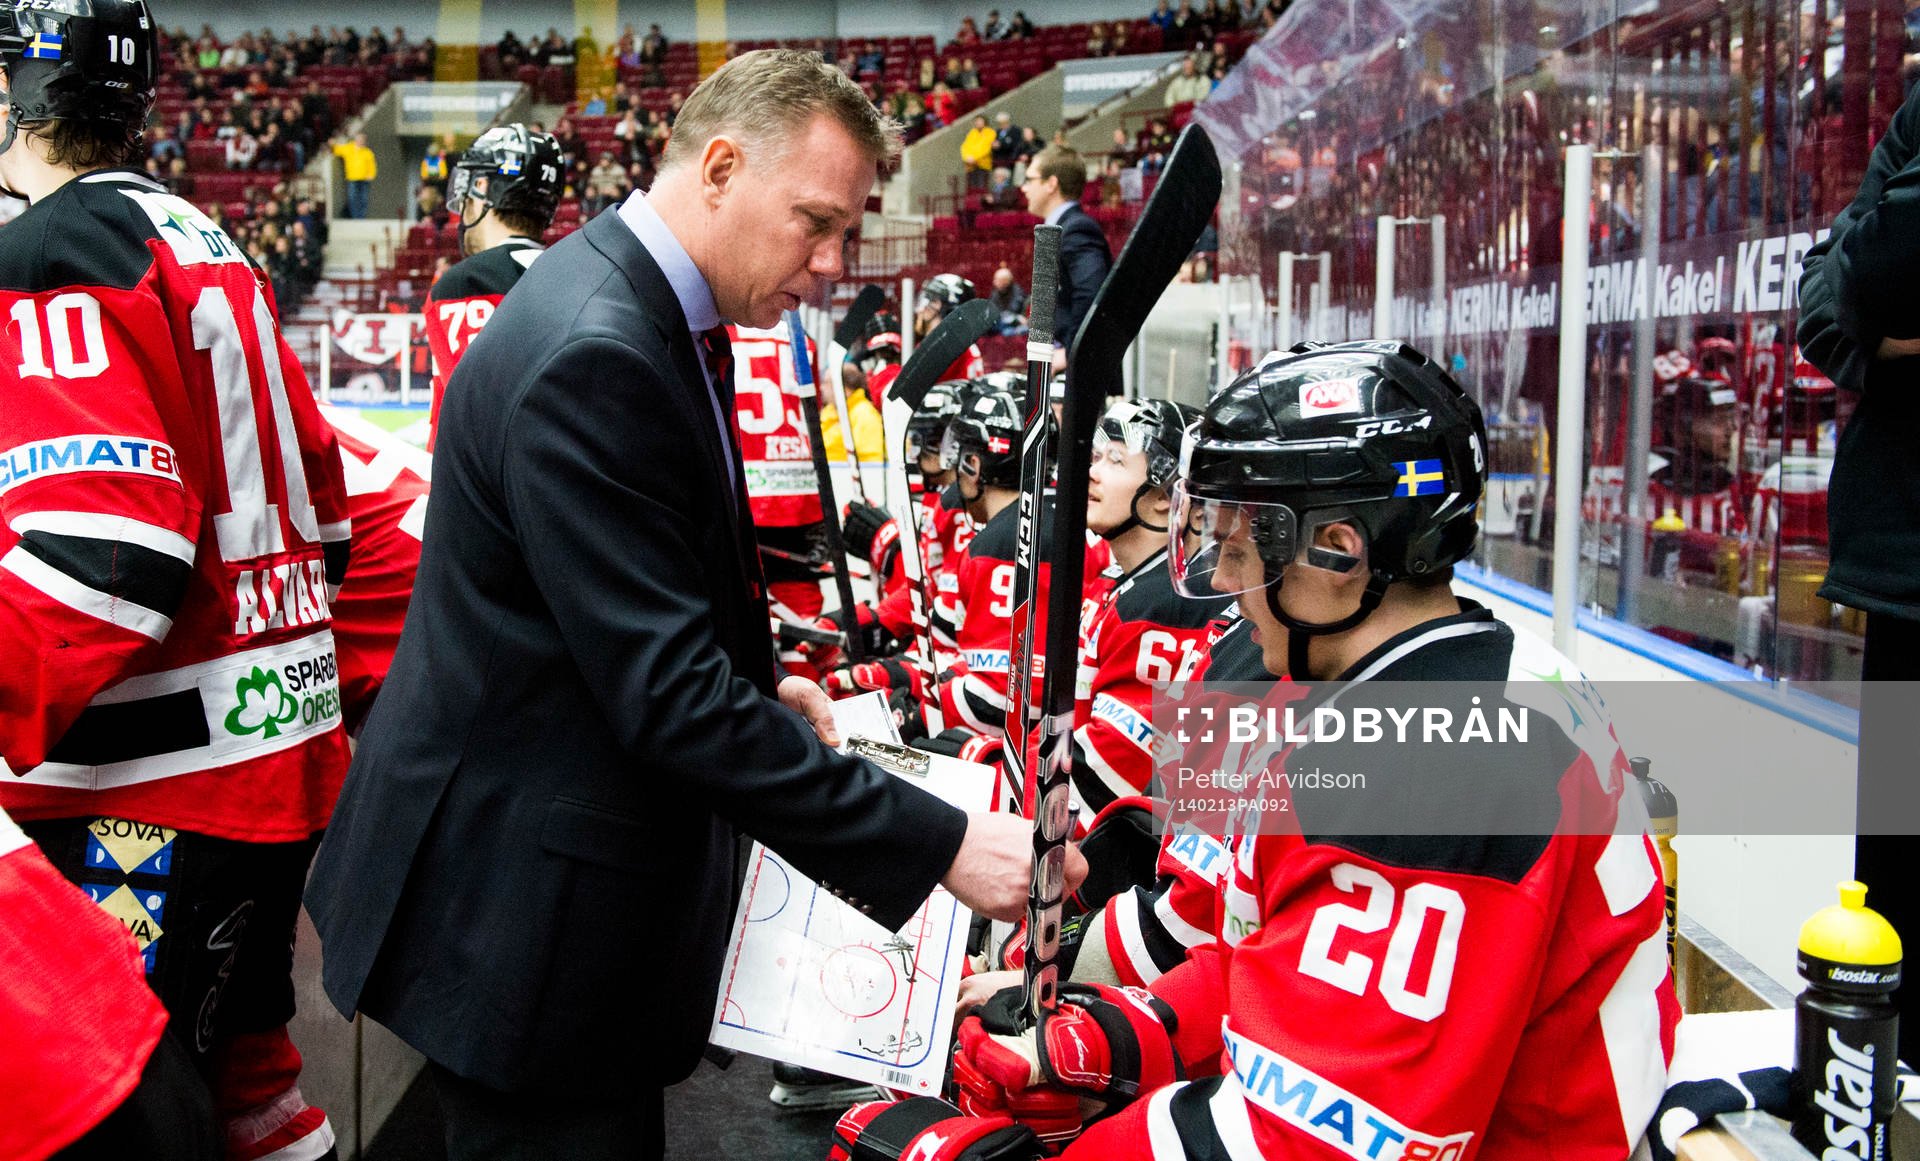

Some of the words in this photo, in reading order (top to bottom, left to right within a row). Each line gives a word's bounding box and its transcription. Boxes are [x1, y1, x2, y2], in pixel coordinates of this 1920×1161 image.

[108, 35, 135, 66] 10
[541, 164, 557, 183] 79
[188, 221, 239, 258] br
[1451, 281, 1509, 333] KERMA
[1512, 281, 1557, 329] Kakel
[1584, 258, 1648, 324] ERMA
[1654, 256, 1725, 318] Kakel
[1733, 228, 1832, 313] KER
[10, 292, 110, 379] 10
[440, 300, 496, 354] 79
[1355, 415, 1432, 439] CCM
[1018, 491, 1033, 569] CCM
[235, 559, 333, 635] ALVAR
[284, 651, 338, 692] SPARB
[1136, 630, 1197, 700] 61
[302, 686, 340, 726] ÖRES
[97, 818, 165, 843] SOVA
[120, 917, 151, 942] VA
[1298, 863, 1466, 1022] 20
